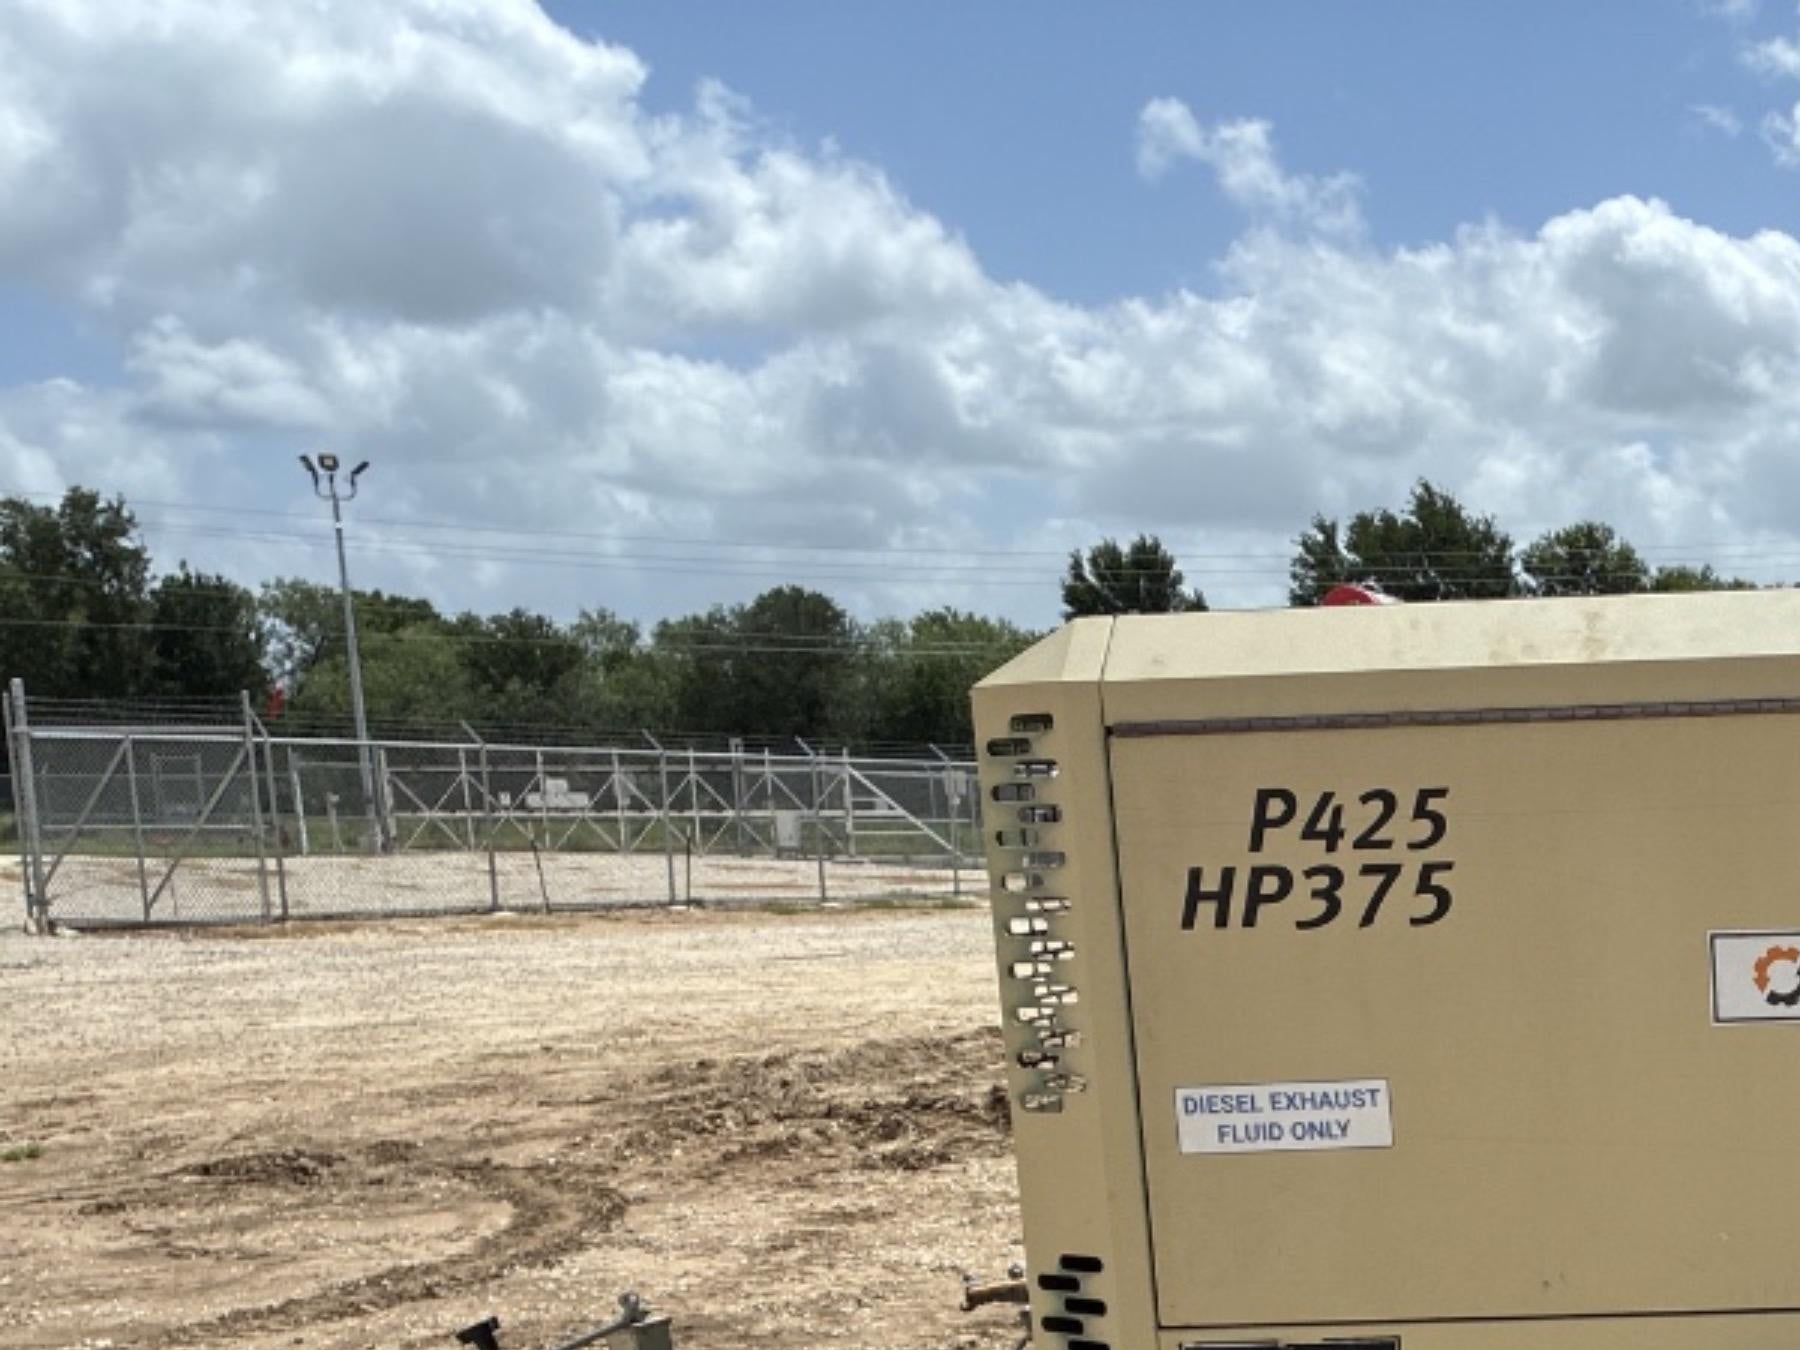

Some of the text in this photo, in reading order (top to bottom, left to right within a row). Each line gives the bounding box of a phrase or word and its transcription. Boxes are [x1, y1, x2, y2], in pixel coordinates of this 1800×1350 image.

[1248, 787, 1450, 853] P425
[1181, 861, 1456, 930] HP375
[1182, 1088, 1381, 1116] DIESEL EXHAUST
[1216, 1118, 1351, 1144] FLUID ONLY
